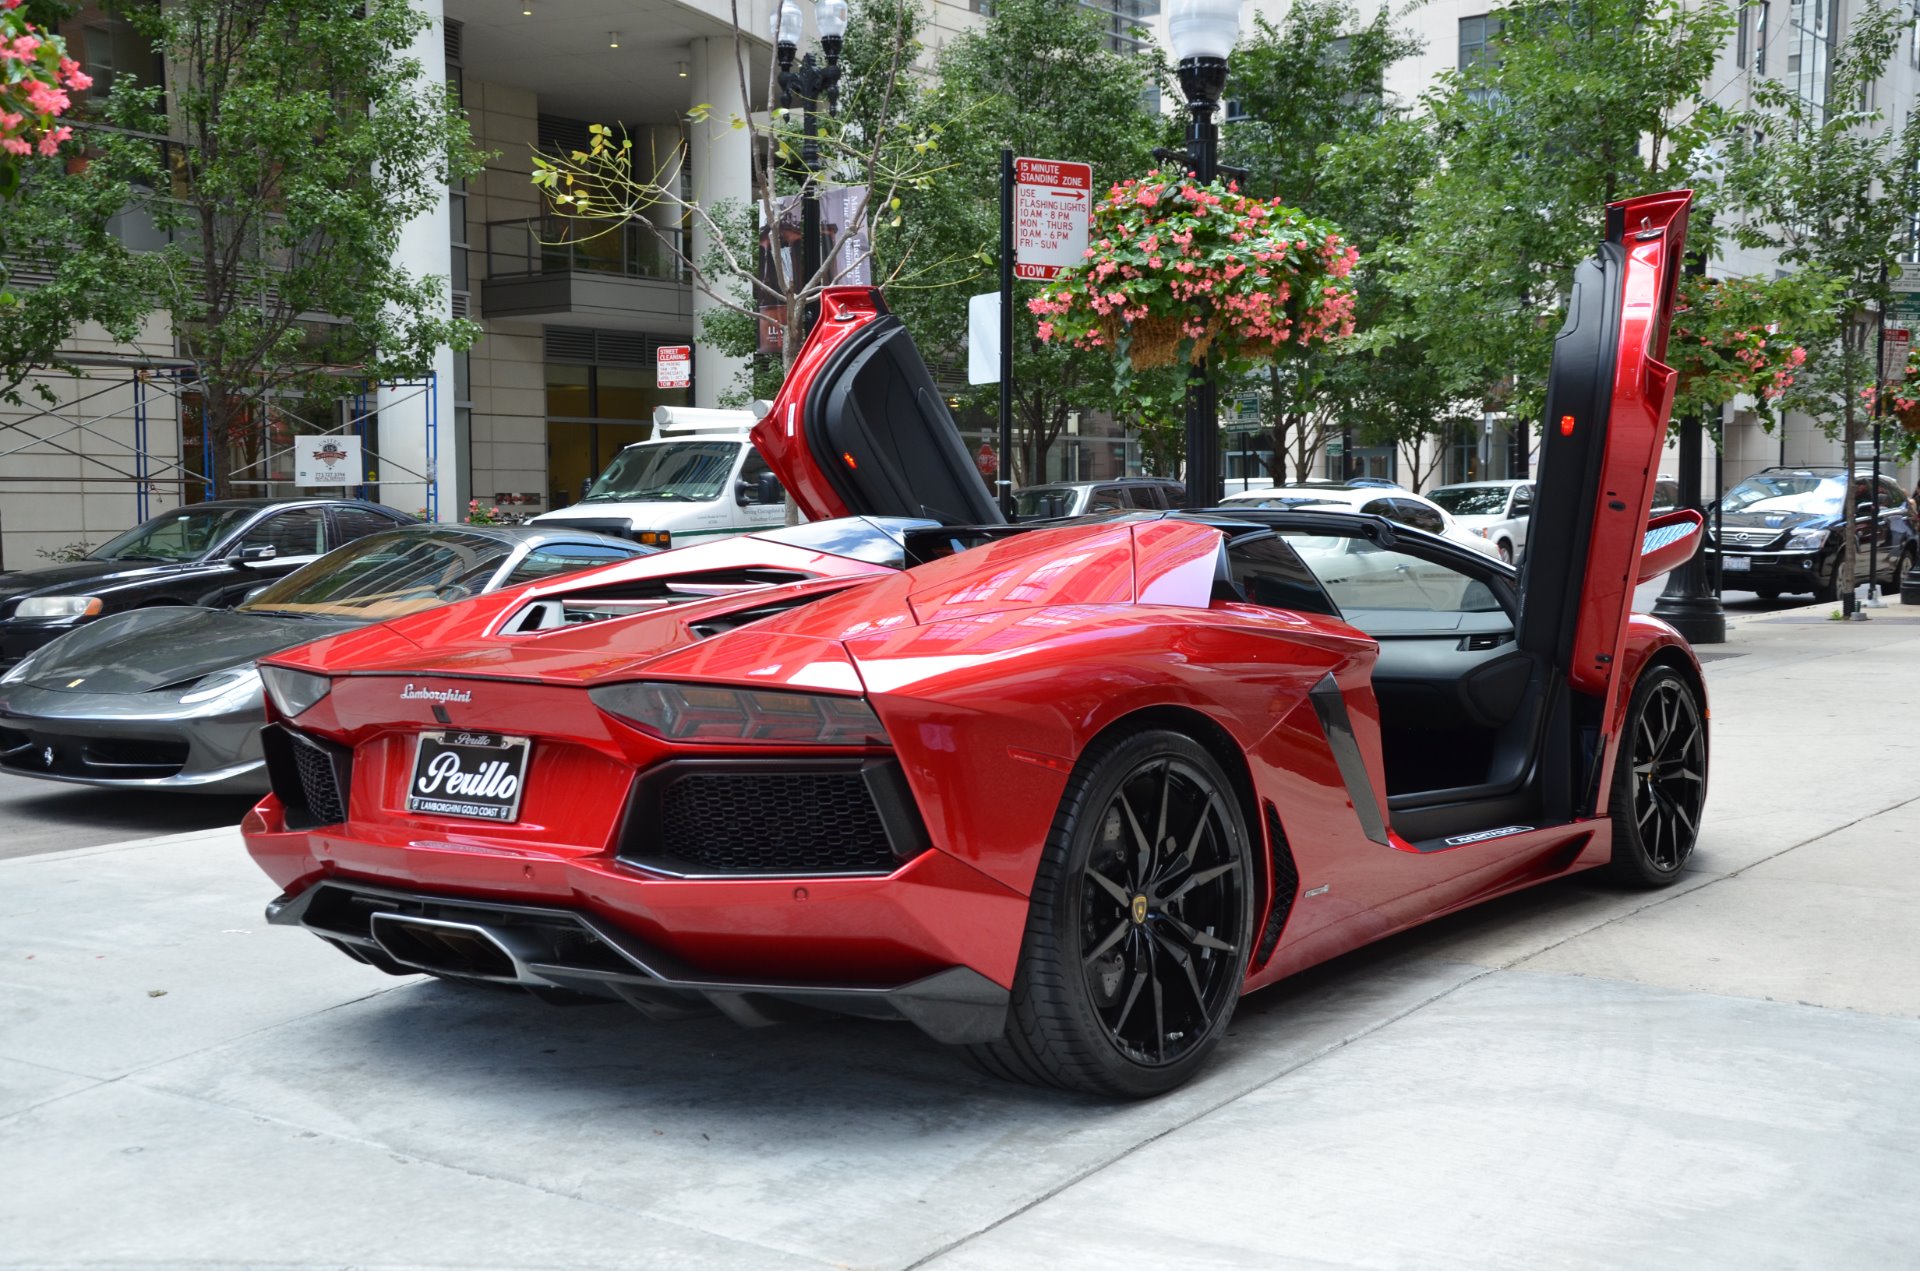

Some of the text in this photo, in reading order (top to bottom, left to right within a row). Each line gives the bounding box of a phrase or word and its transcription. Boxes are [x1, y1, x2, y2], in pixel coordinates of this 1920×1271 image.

[1020, 162, 1060, 174] 15 MINUTE
[1020, 172, 1083, 186] STANDING ZONE
[1020, 188, 1036, 198] USE
[1020, 199, 1086, 212] FLASHING LIGHTS
[1050, 211, 1056, 219] 8
[1058, 211, 1069, 220] PM
[1020, 219, 1037, 227] MON
[1047, 221, 1073, 230] THURS
[1057, 232, 1068, 240] PM
[1020, 239, 1033, 247] FRI
[1041, 240, 1057, 249] SUN
[1020, 265, 1046, 277] TOW
[400, 684, 472, 704] Lamborghini
[454, 733, 491, 746] Perillo
[418, 752, 518, 798] Perillo
[421, 801, 499, 816] LAMBORGHINI GOLD COAST
